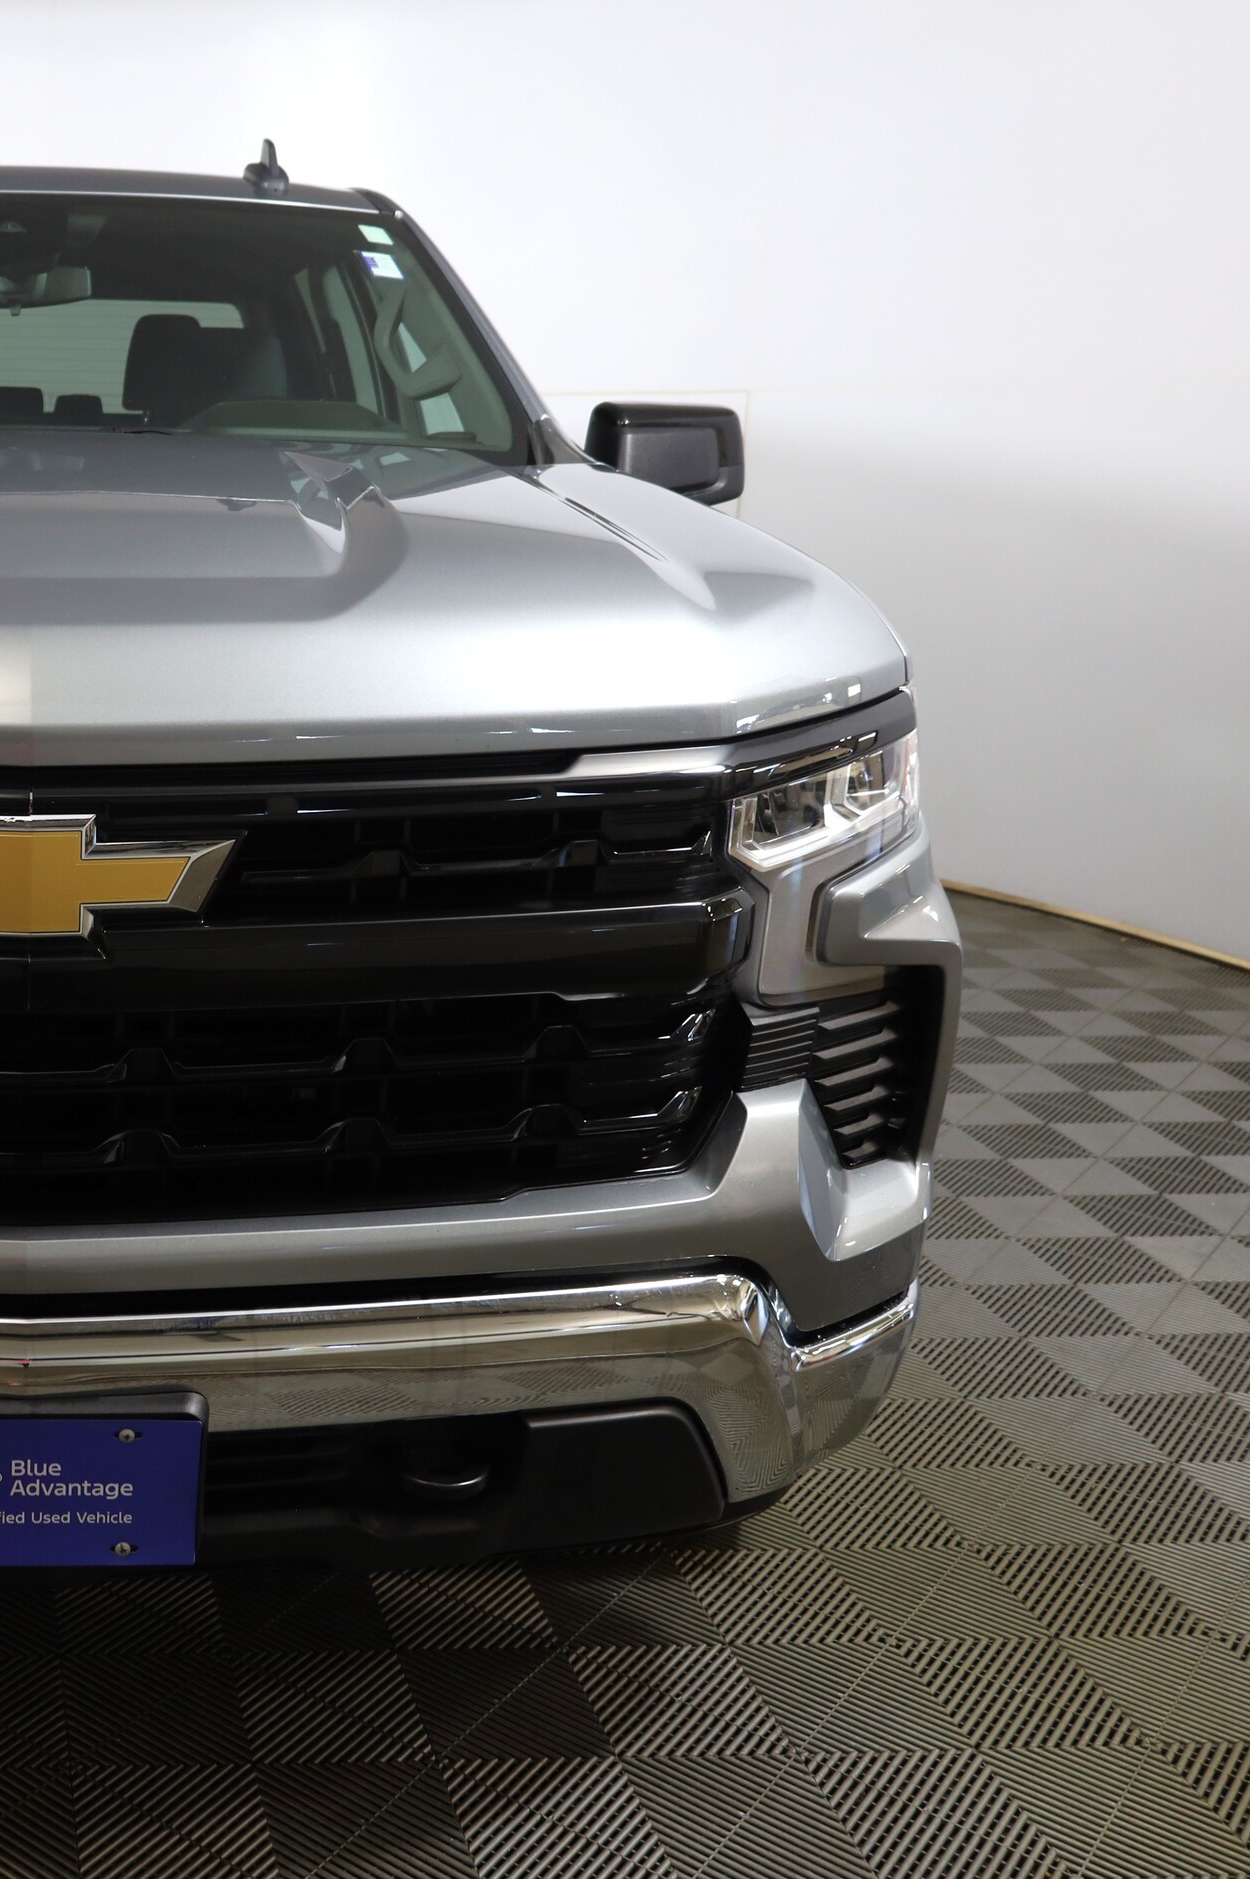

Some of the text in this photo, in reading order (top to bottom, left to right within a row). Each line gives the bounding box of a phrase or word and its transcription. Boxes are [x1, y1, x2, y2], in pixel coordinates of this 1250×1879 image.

[11, 1459, 62, 1476] Blue
[10, 1479, 134, 1500] Advantage
[31, 1511, 71, 1524] Used
[76, 1511, 133, 1524] Vehicle
